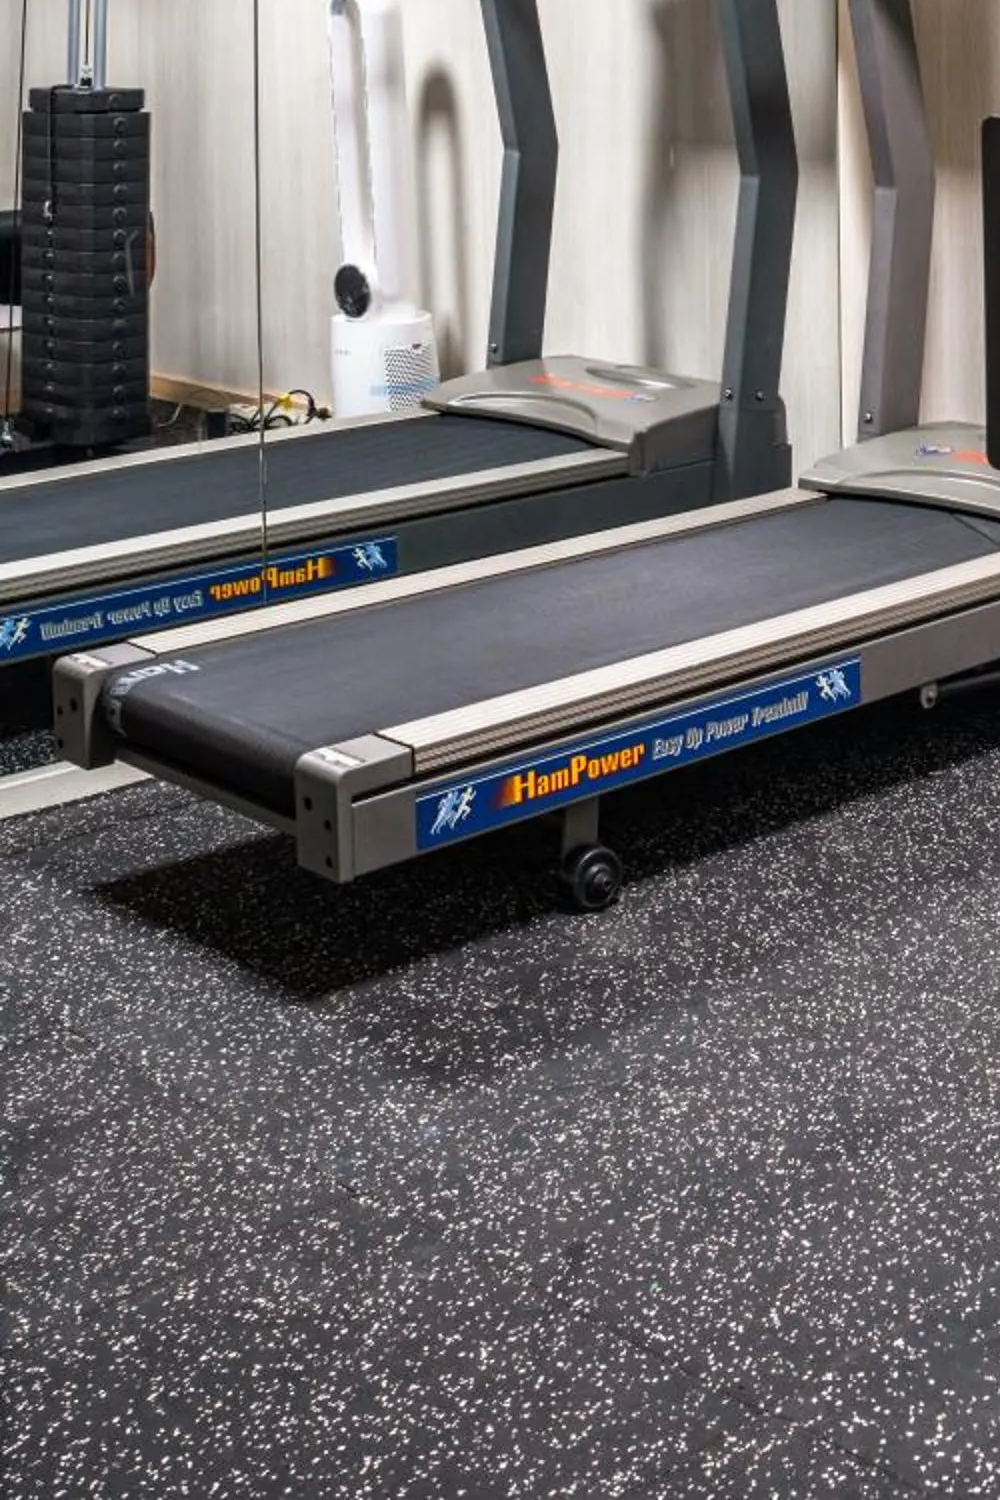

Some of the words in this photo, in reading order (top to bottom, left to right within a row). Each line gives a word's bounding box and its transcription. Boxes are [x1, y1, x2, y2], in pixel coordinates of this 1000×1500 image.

[510, 743, 645, 804] HamPower
[652, 735, 684, 761] Easy
[706, 713, 749, 743] Power
